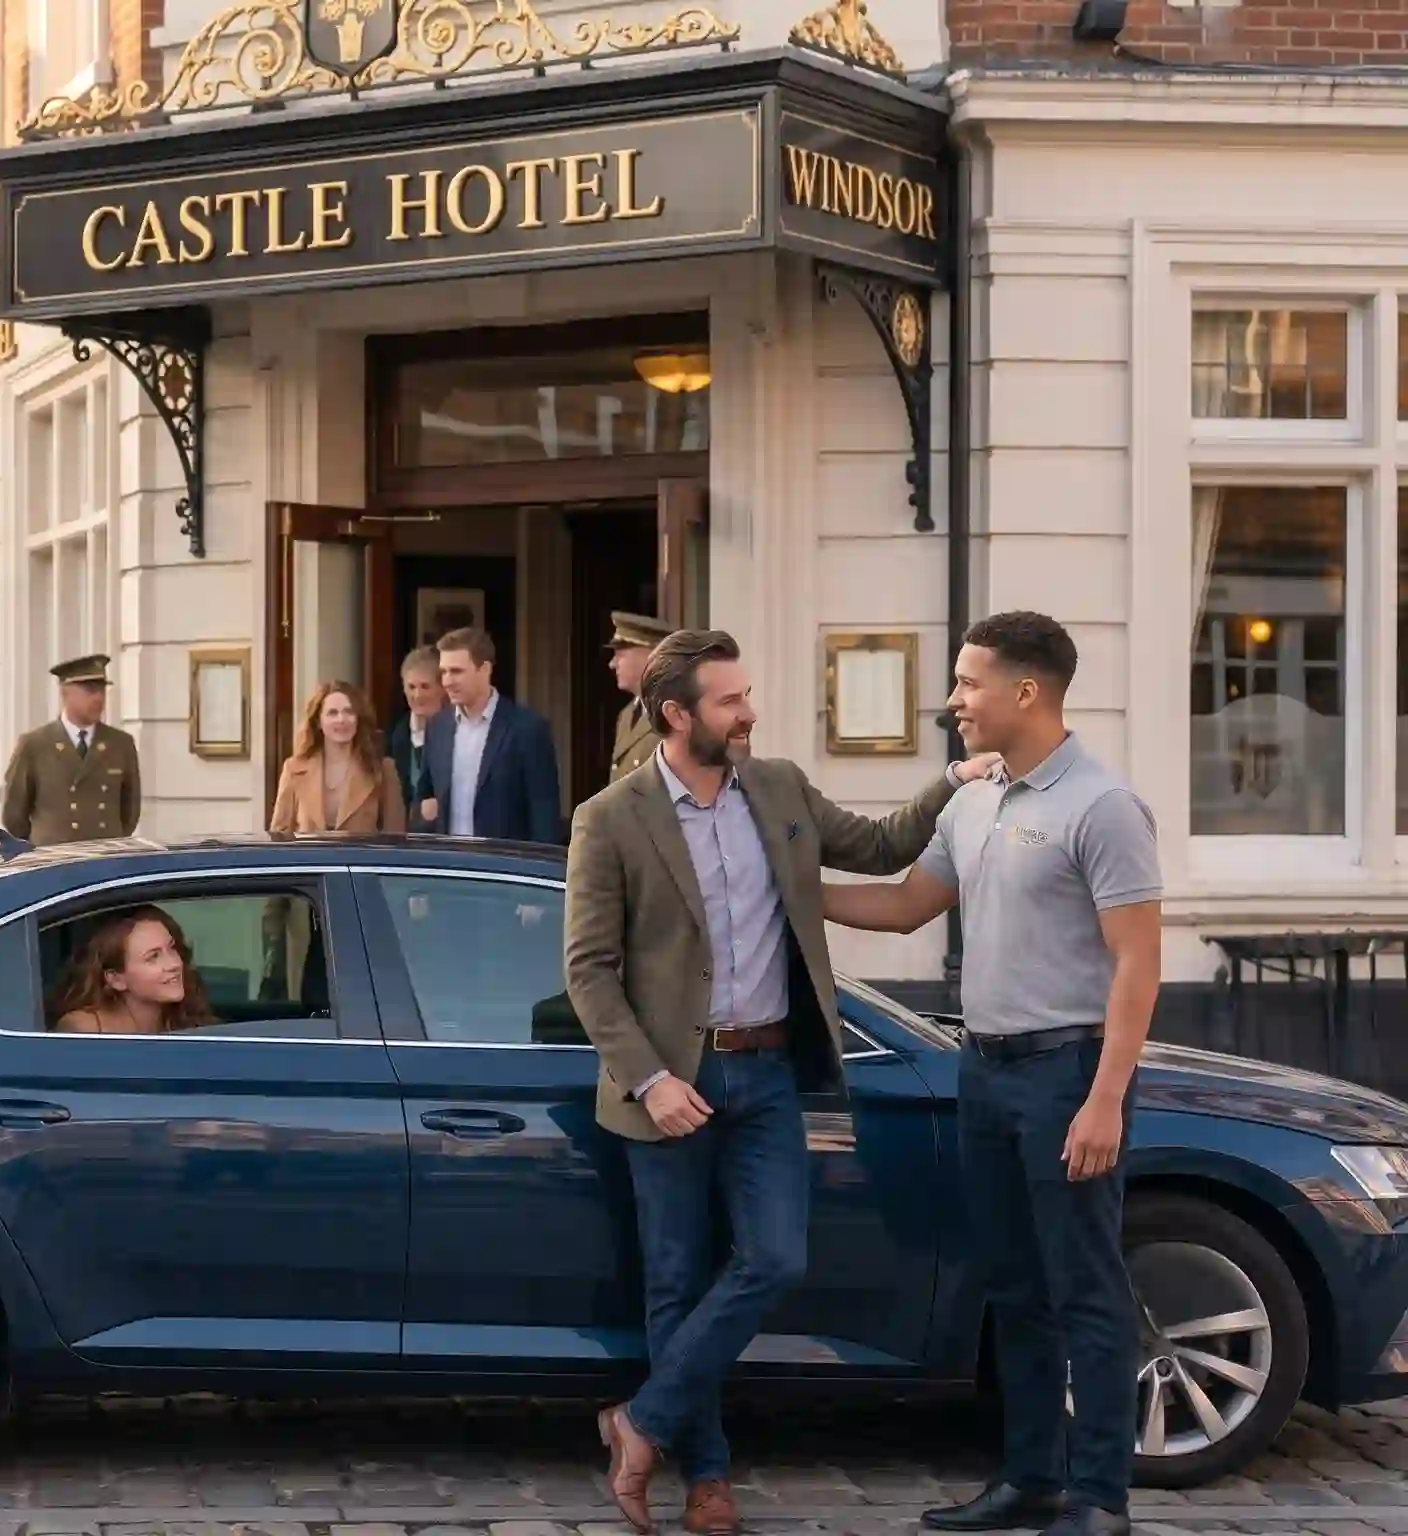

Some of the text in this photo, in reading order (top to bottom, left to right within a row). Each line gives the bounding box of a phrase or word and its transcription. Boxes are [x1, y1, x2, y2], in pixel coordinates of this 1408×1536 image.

[80, 147, 664, 272] CASTLE HOTEL
[785, 143, 937, 240] WINDSOR
